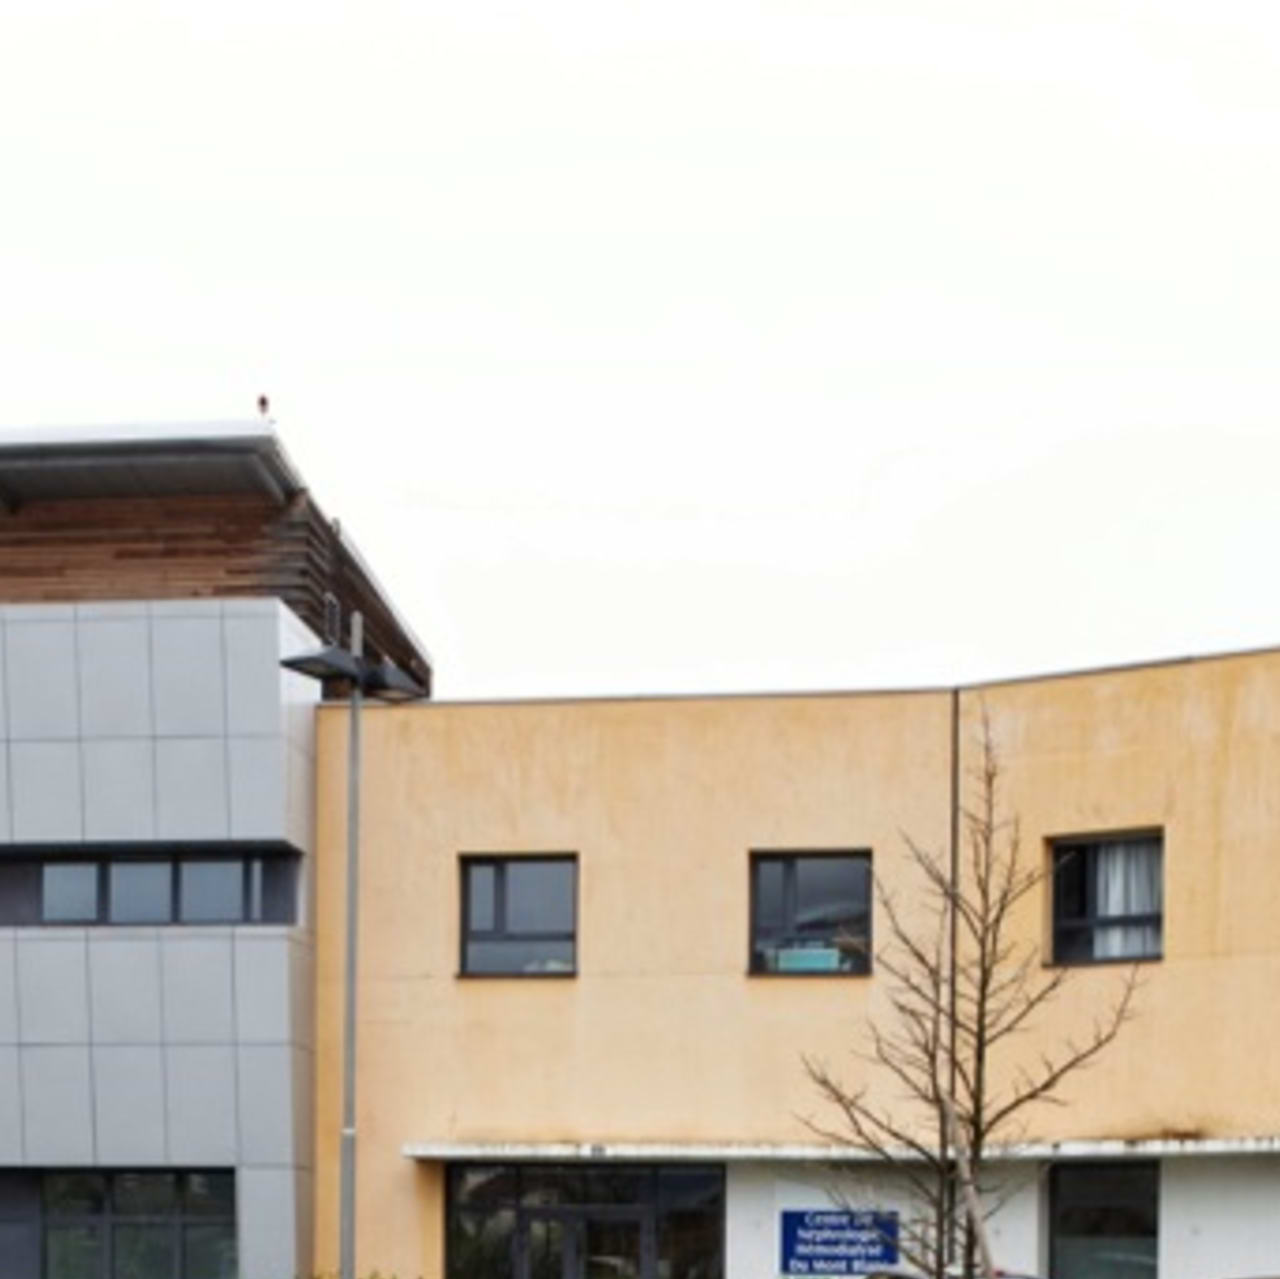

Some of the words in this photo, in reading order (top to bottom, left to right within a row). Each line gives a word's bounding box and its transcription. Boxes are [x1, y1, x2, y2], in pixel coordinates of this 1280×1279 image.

[804, 1211, 850, 1227] Centre
[789, 1259, 809, 1272] Du
[812, 1259, 847, 1272] Mont
